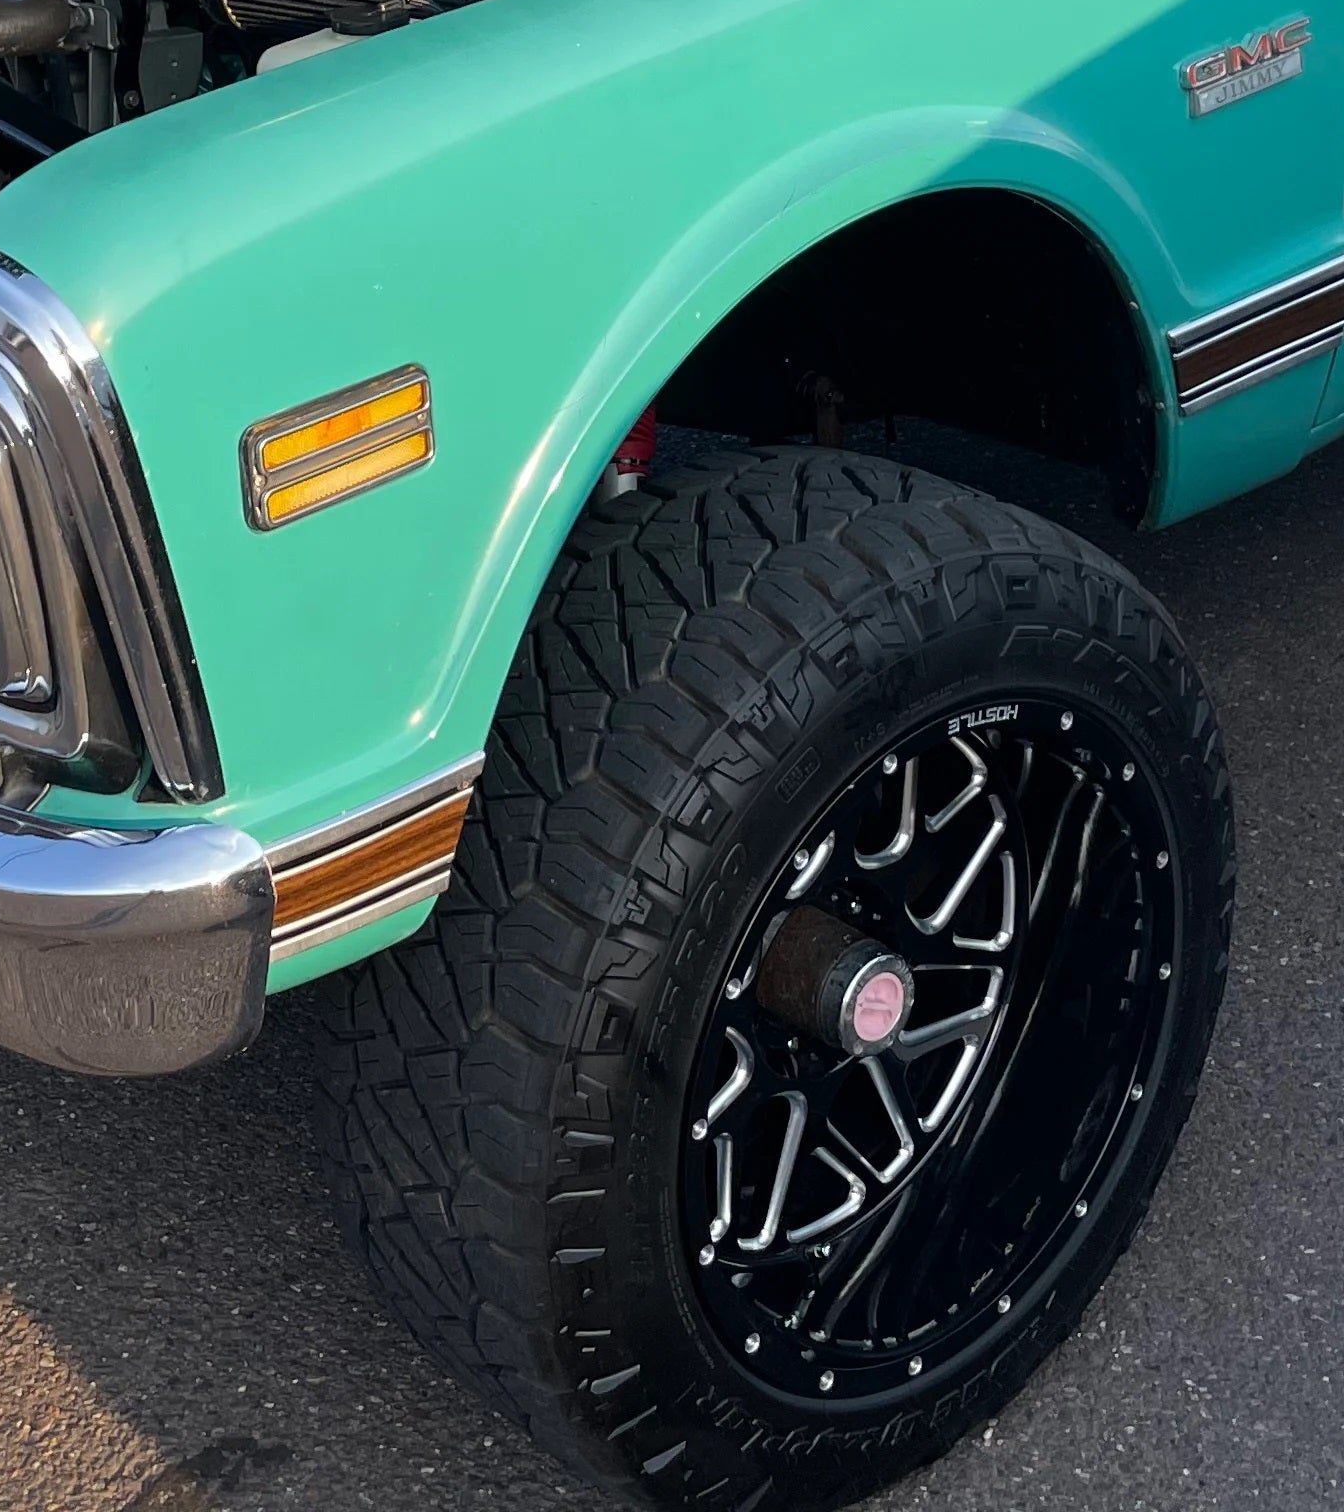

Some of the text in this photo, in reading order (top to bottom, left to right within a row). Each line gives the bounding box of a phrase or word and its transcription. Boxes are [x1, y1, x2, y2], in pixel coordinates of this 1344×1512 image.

[1182, 15, 1313, 88] GMC
[1215, 59, 1287, 104] JIMMY
[947, 704, 1019, 736] HOSTILE
